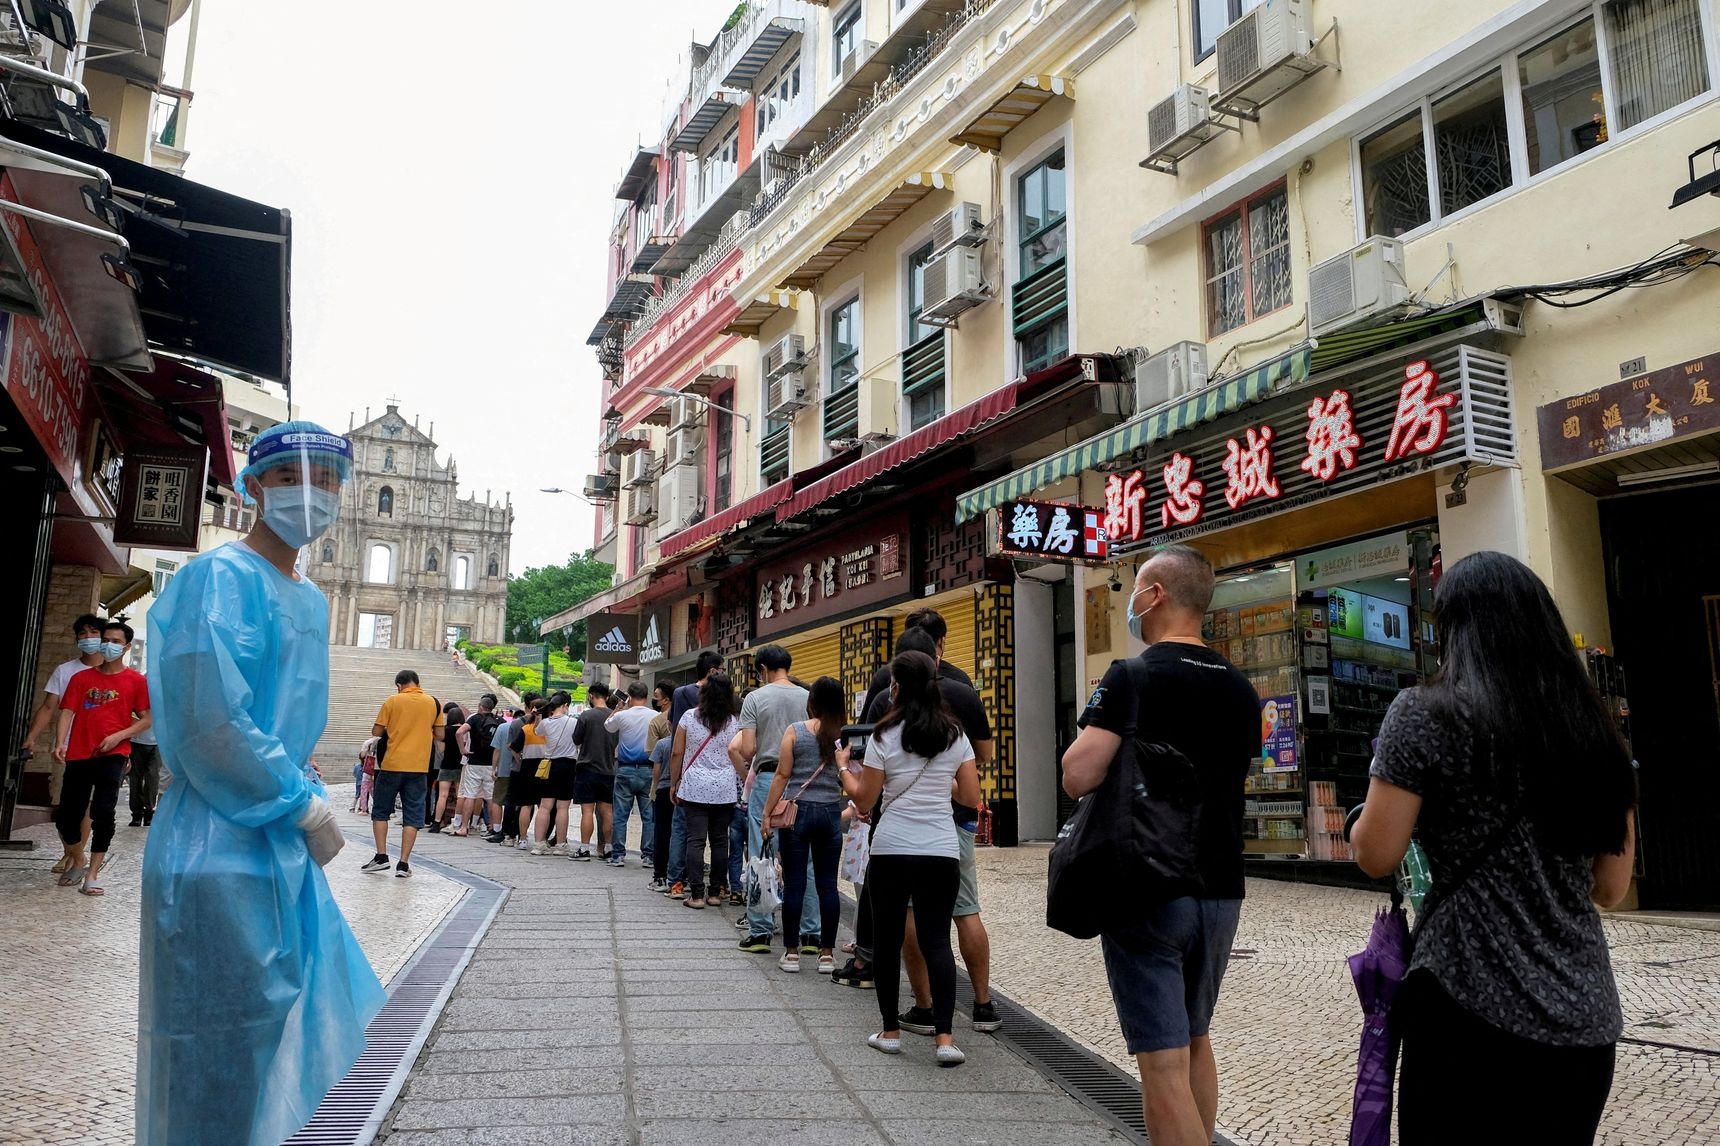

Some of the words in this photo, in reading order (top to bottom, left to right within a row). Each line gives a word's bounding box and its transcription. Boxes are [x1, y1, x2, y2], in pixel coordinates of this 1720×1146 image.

[1566, 392, 1600, 410] EDIFICIO
[1632, 377, 1650, 390] KOK
[1685, 361, 1703, 375] WUI
[21, 336, 79, 468] 6610-7590
[289, 434, 313, 442] Face
[315, 434, 342, 446] Shield
[142, 470, 161, 502] 餅家
[1007, 503, 1079, 555] 藥房
[594, 641, 632, 653] adidas
[639, 644, 662, 663] adidas
